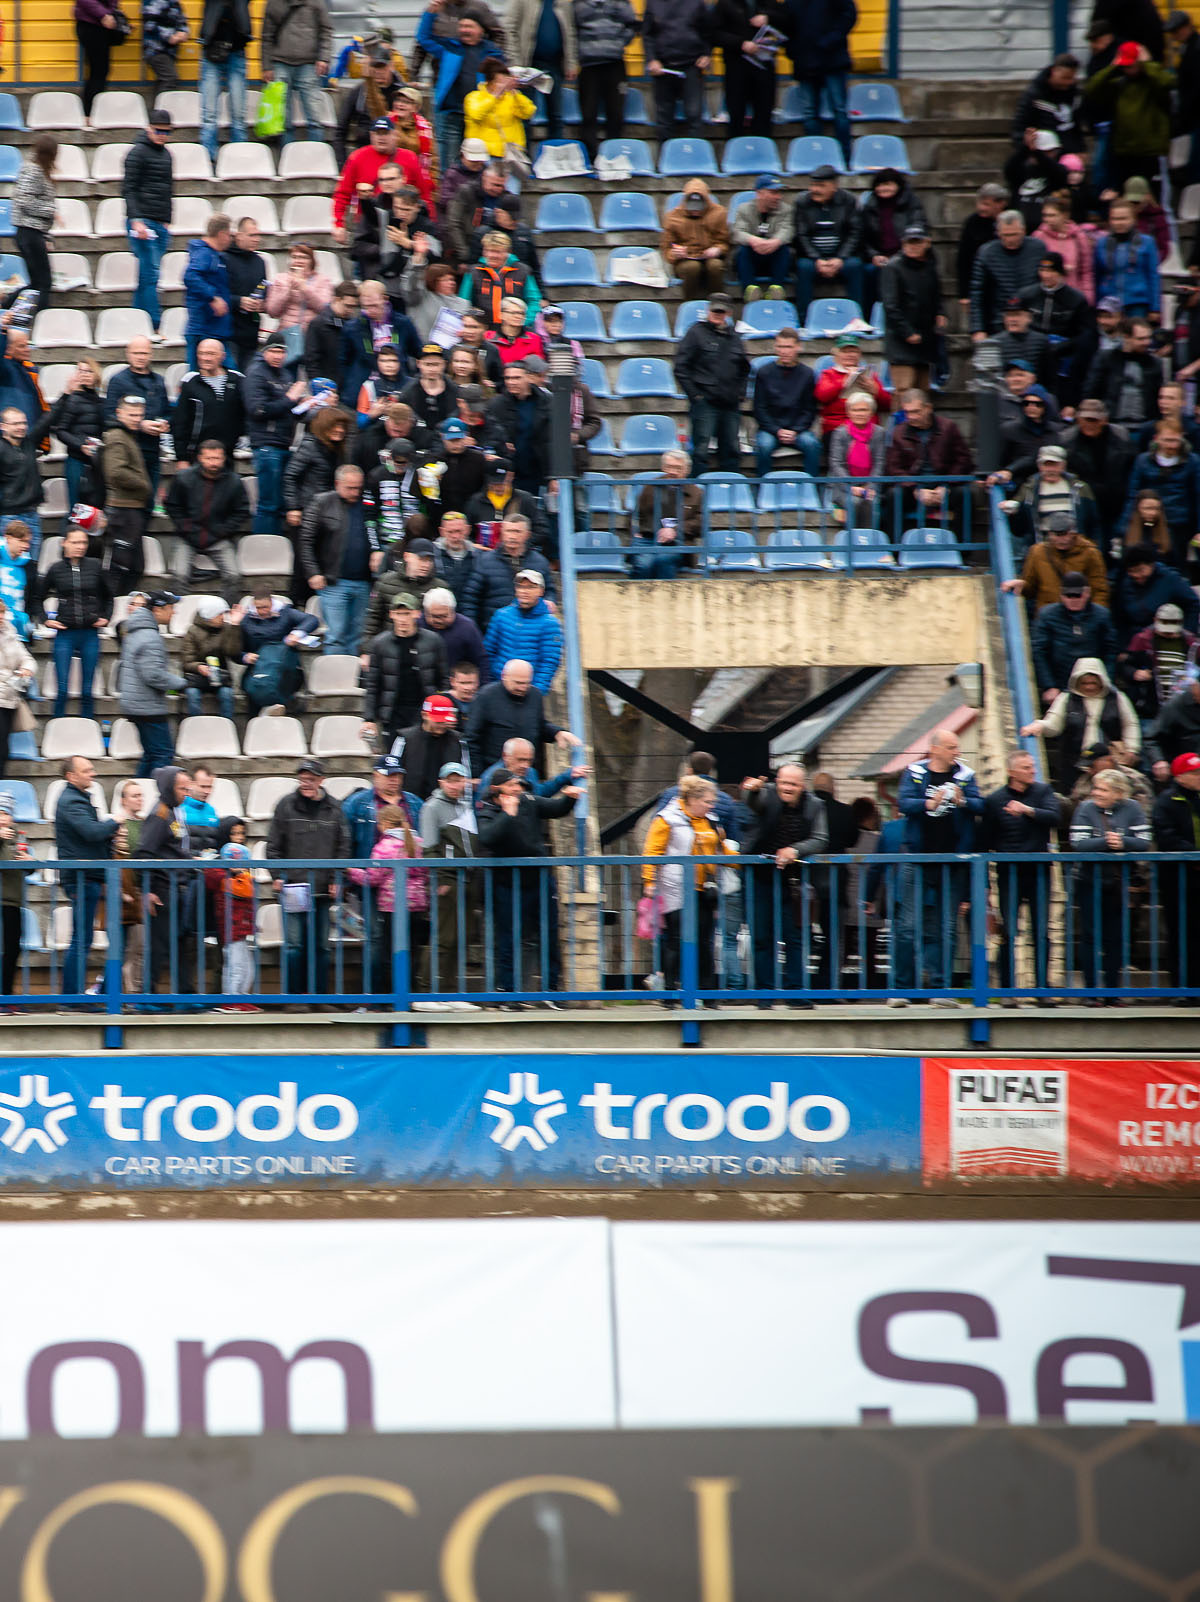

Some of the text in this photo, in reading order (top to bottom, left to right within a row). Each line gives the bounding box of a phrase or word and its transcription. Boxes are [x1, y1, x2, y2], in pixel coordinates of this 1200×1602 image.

[957, 1076, 1059, 1103] PUFAS
[88, 1081, 359, 1143] trodo
[578, 1081, 851, 1143] trodo
[104, 1156, 357, 1175] CAR PARTS ONLINE
[594, 1155, 848, 1176] CAR PARTS ONLINE
[855, 1290, 1200, 1425] Se
